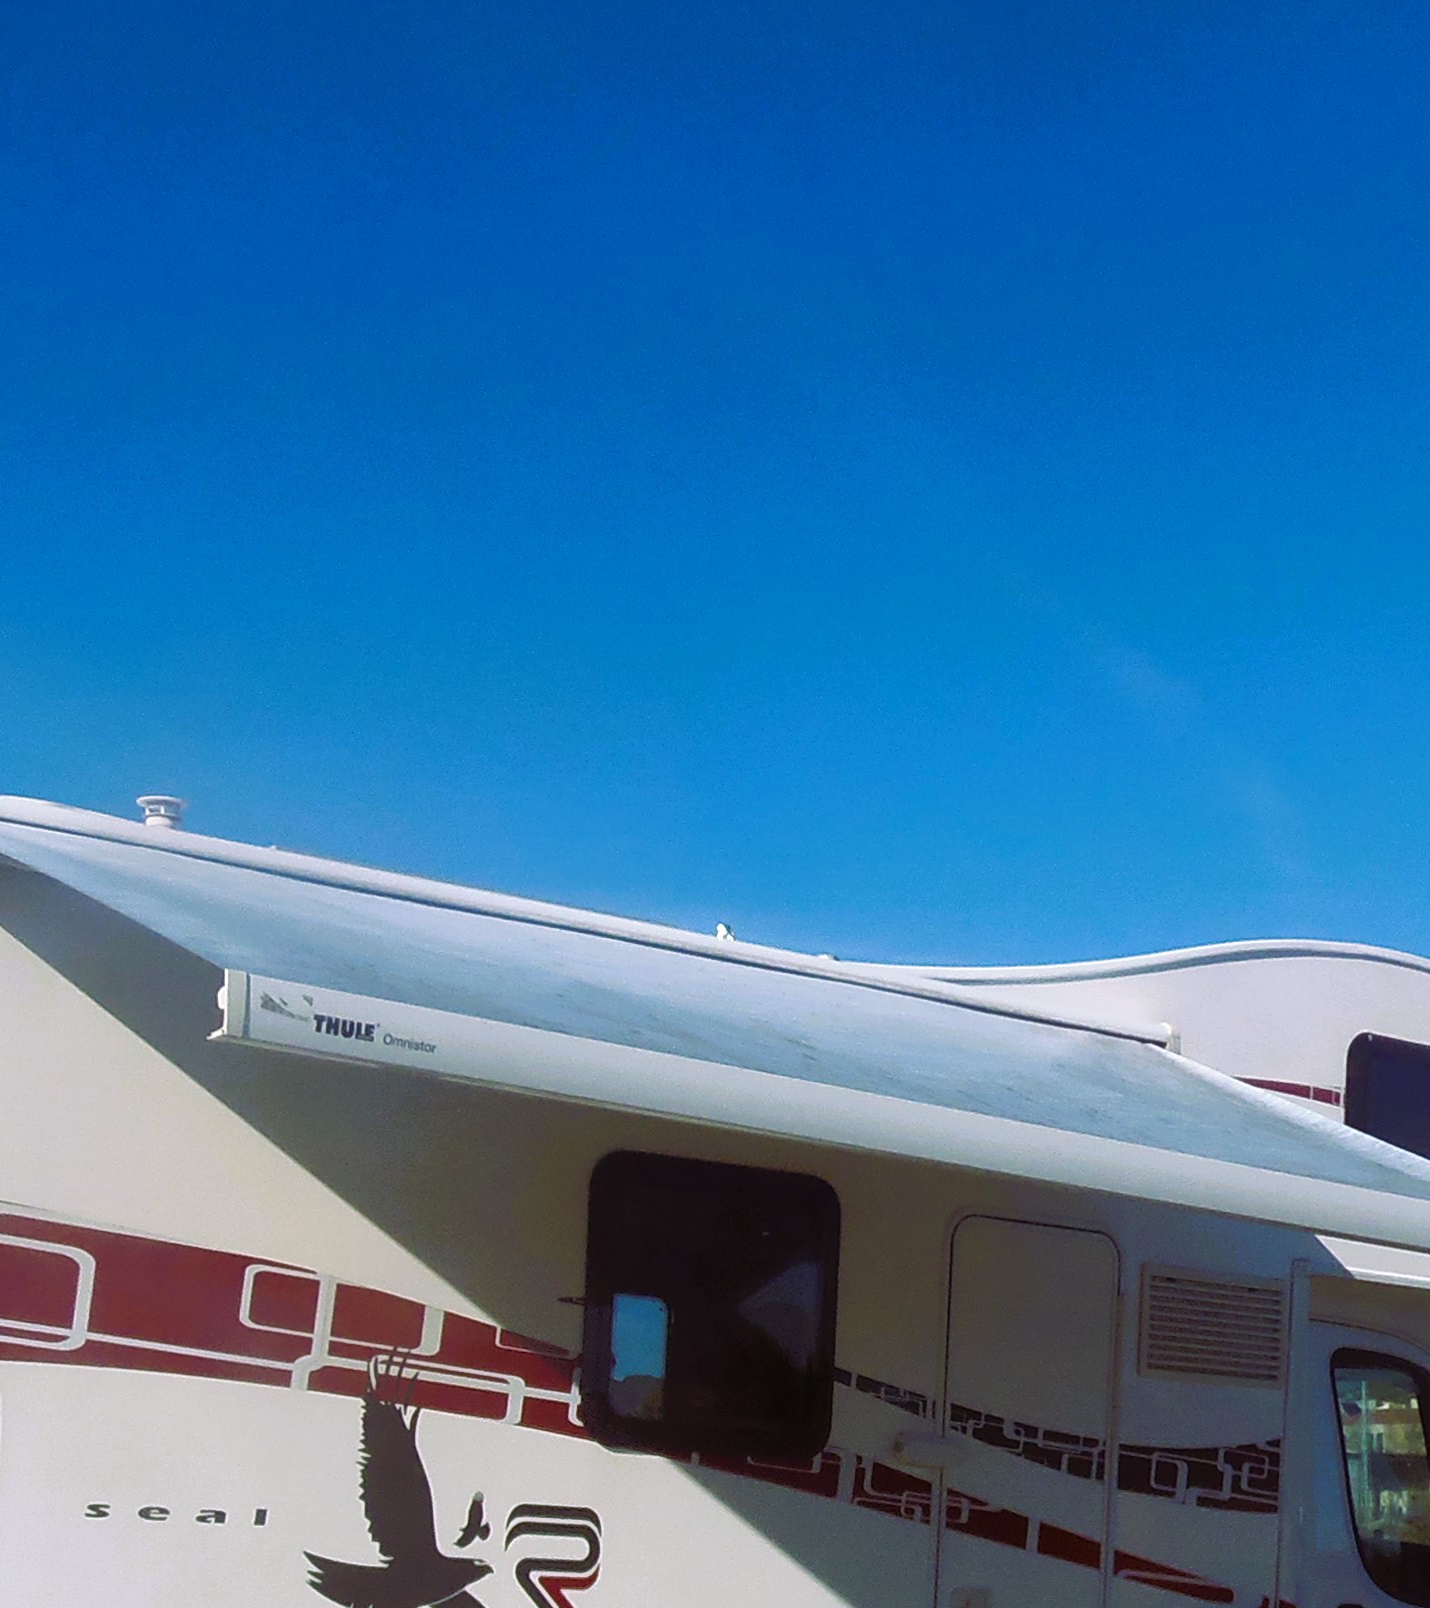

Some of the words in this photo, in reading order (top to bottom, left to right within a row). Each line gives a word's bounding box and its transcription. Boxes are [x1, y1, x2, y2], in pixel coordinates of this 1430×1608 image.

[313, 1013, 376, 1042] THULE
[382, 1033, 437, 1054] Omnistor
[84, 1502, 269, 1527] seal
